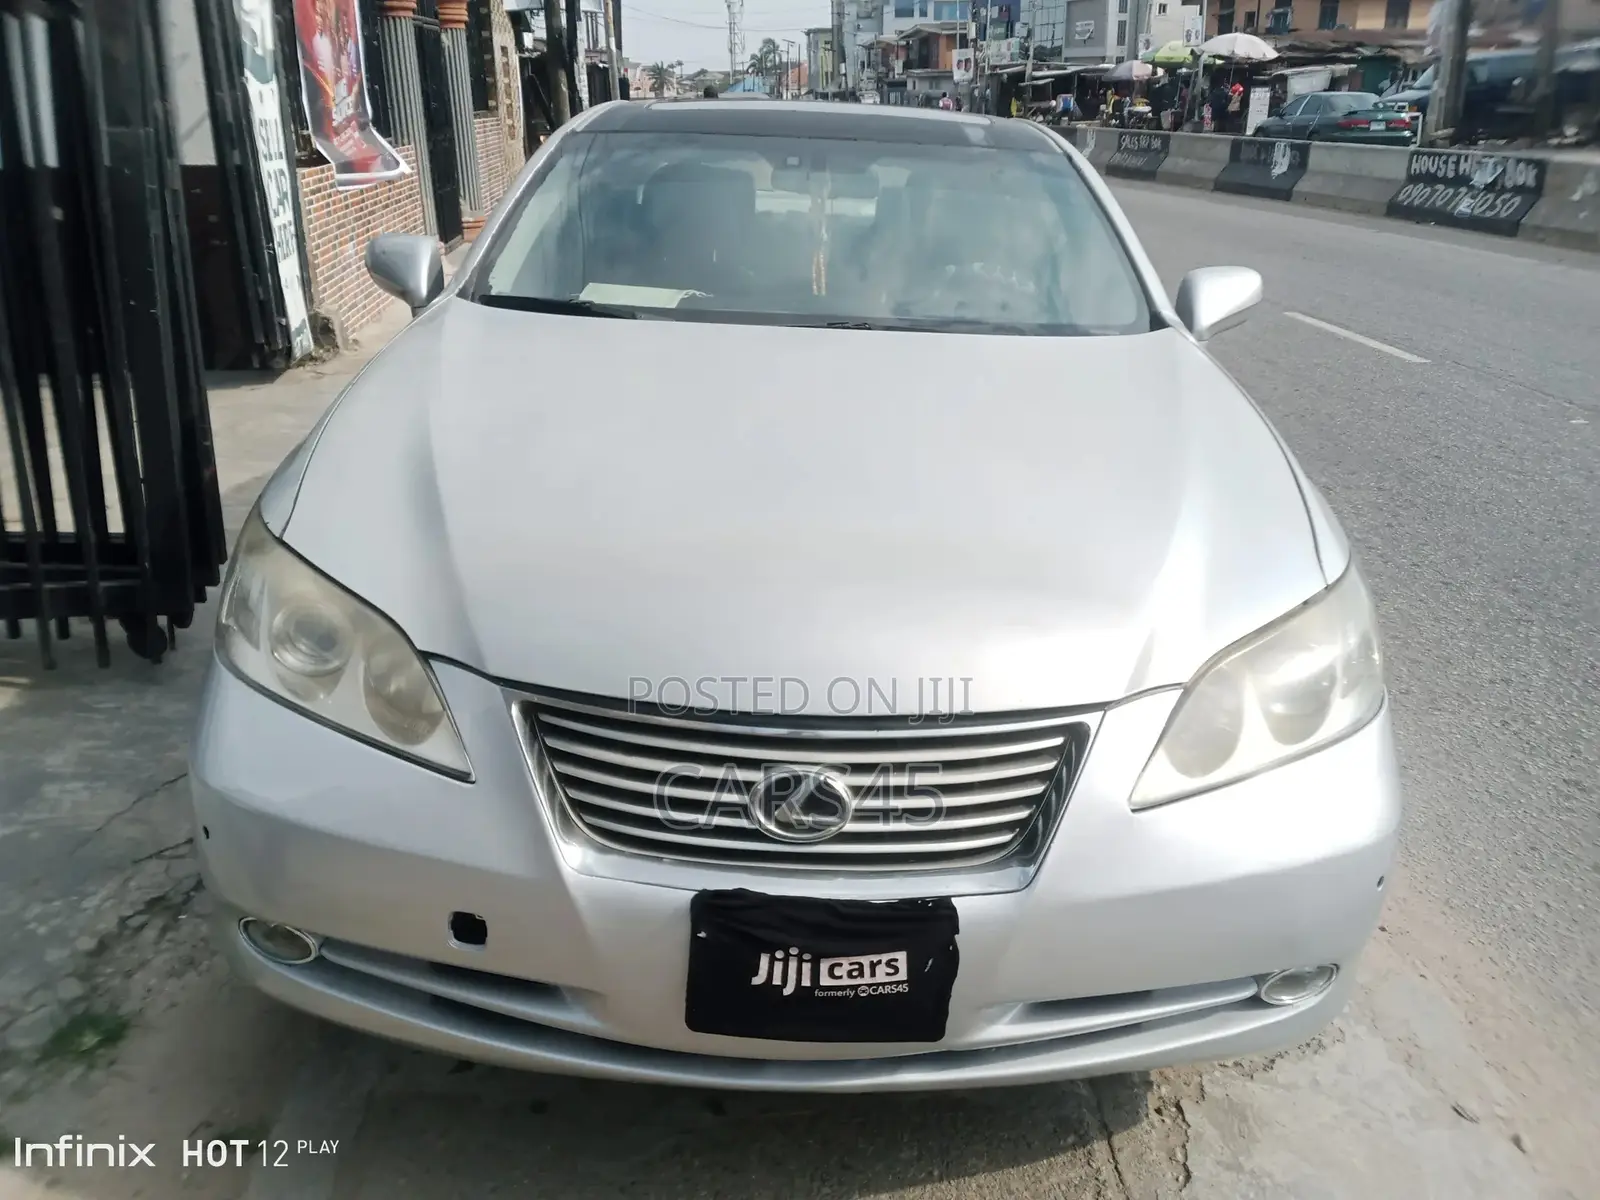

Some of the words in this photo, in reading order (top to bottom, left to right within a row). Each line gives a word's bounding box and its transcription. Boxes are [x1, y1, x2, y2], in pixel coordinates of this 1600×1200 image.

[1410, 153, 1457, 179] HOUSE
[751, 946, 813, 997] Jiji
[826, 956, 901, 981] cars
[814, 987, 856, 999] formerly
[868, 983, 909, 996] CARS45
